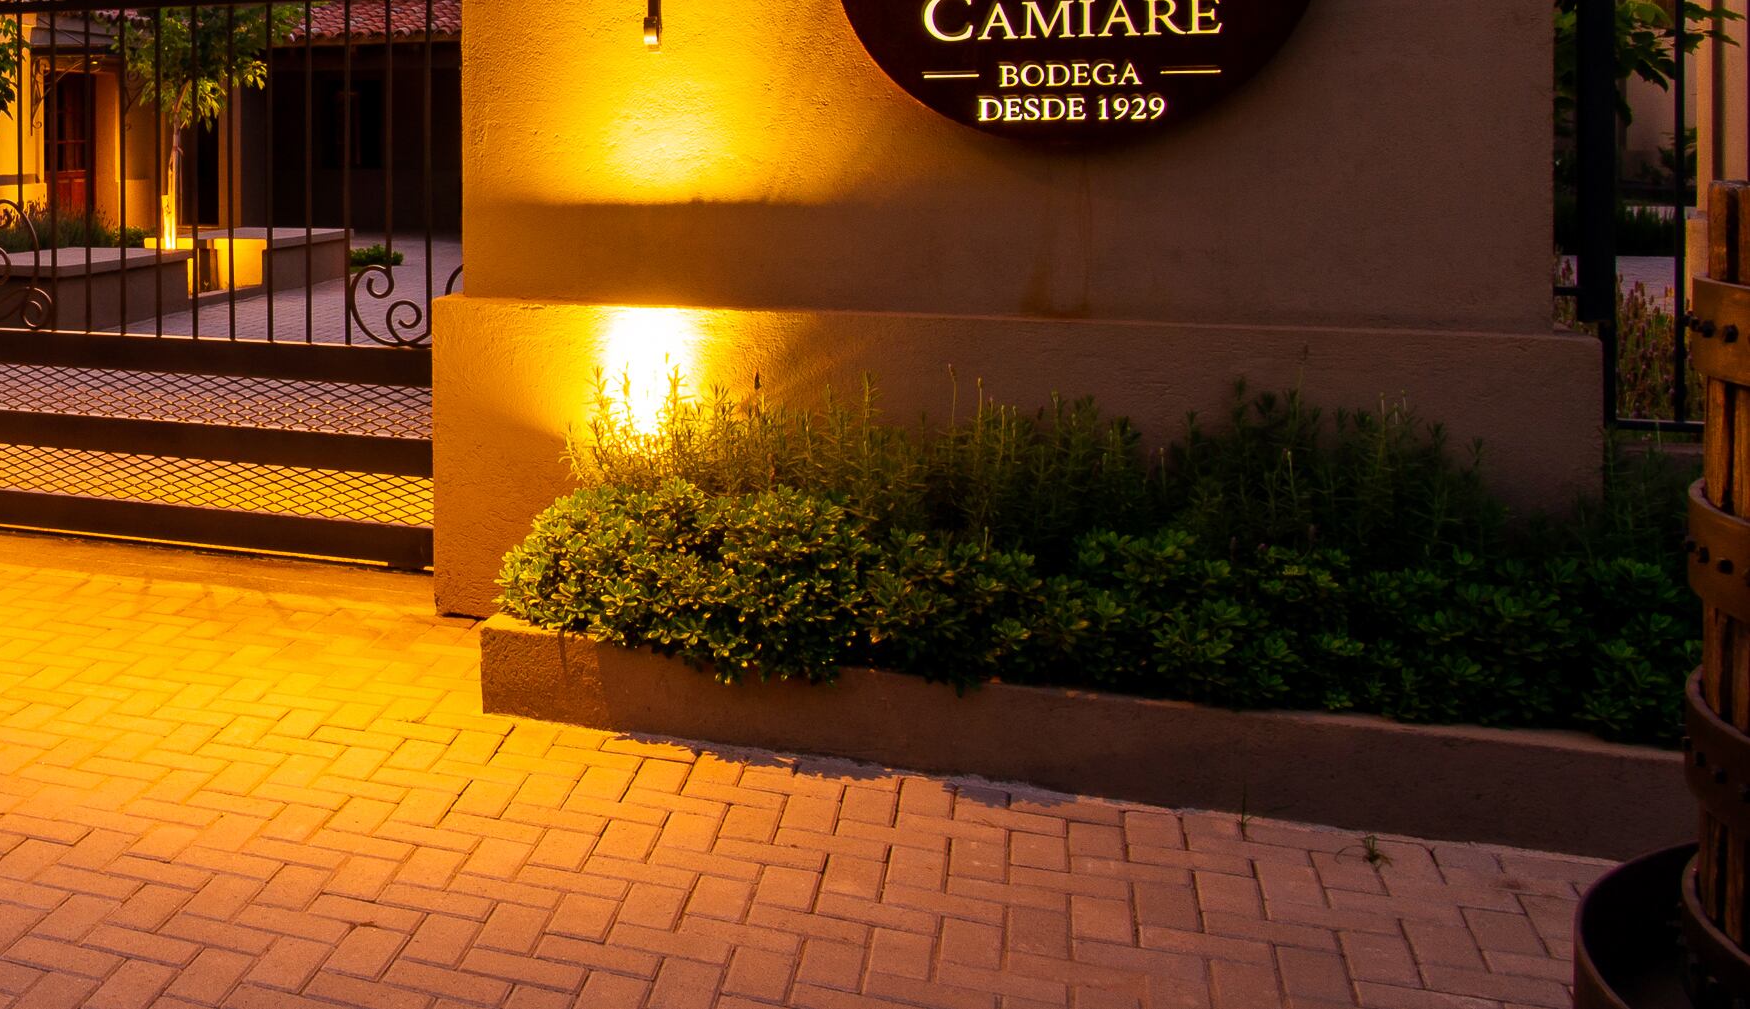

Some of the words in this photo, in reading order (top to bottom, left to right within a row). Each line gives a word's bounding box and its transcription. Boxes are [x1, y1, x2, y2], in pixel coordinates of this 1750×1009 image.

[998, 62, 1143, 88] BODEGA
[977, 97, 1087, 122] DESDE
[1098, 97, 1166, 121] 1929
